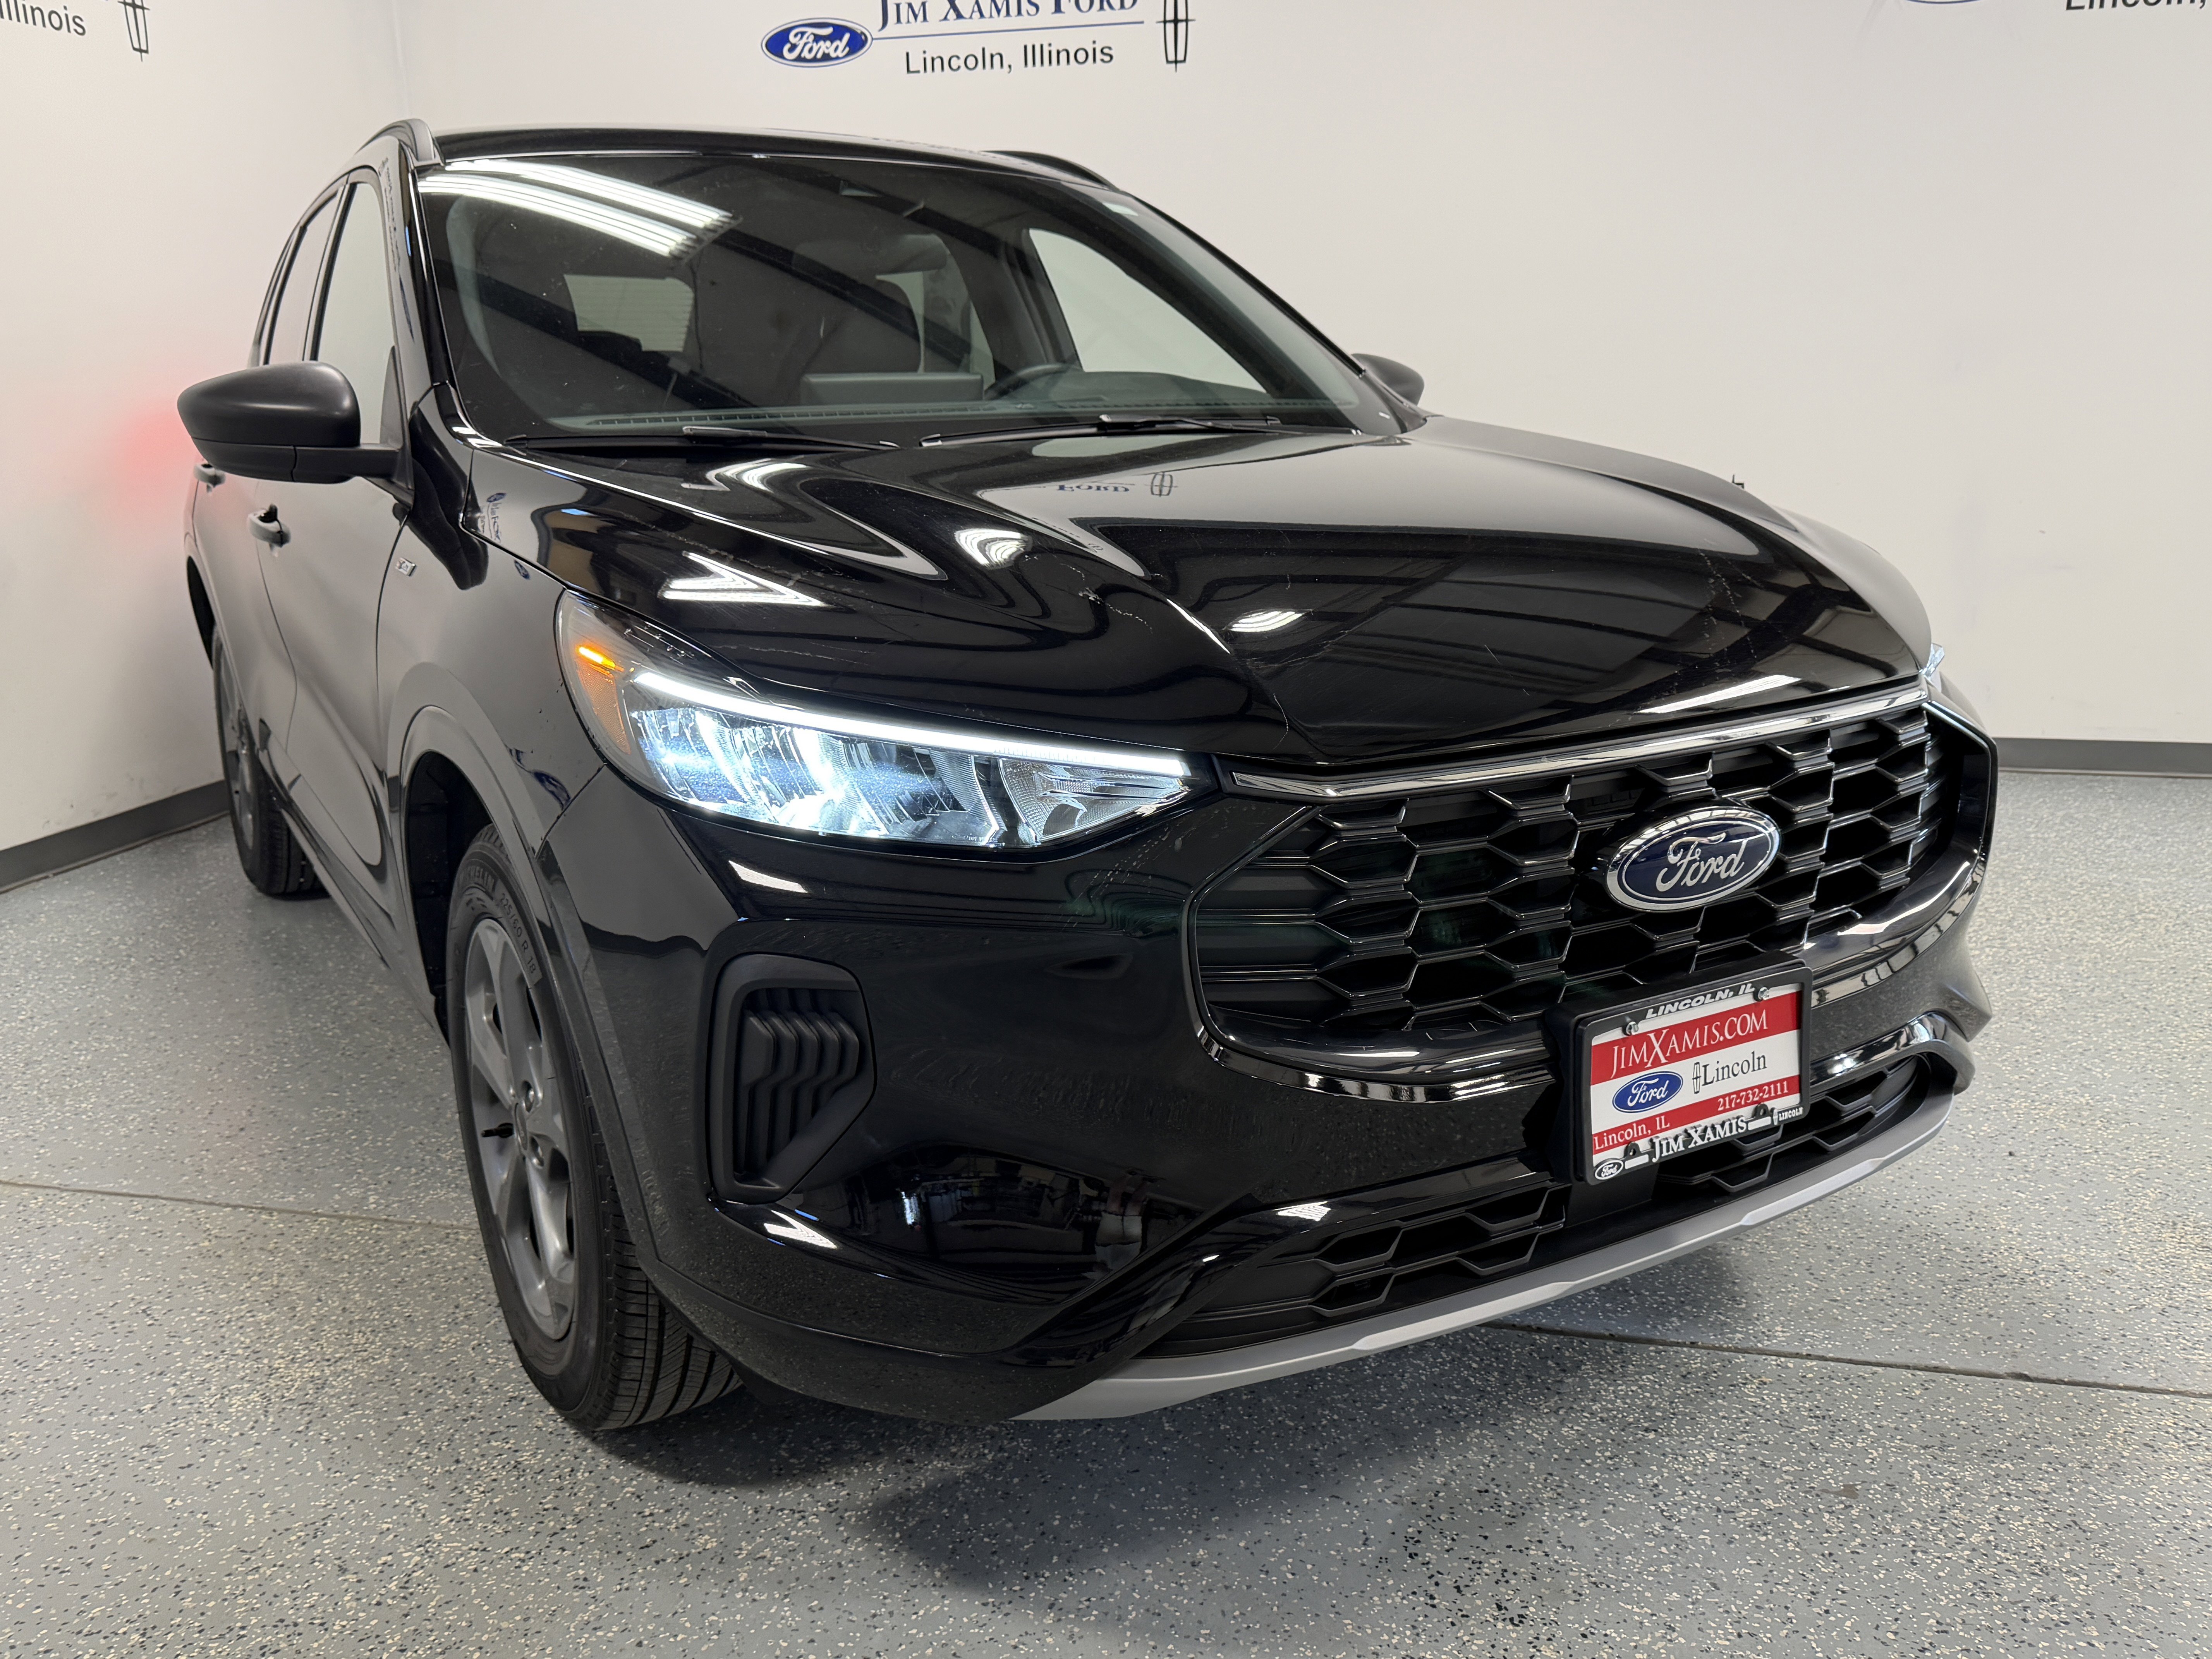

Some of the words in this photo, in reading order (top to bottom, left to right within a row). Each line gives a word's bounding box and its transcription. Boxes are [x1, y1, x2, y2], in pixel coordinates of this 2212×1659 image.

[878, 0, 929, 32] JIM
[939, 0, 1040, 22] XAMIS
[782, 26, 850, 60] Ford
[906, 46, 1012, 74] Lincoln,
[1024, 40, 1114, 68] Illinois
[1656, 832, 1748, 892] Ford
[521, 940, 529, 952] R
[1645, 988, 1734, 1019] LINCOLN,
[1738, 983, 1755, 995] IL
[1610, 1009, 1768, 1079] JIMXAMIS.COM
[1702, 1051, 1767, 1086] Lincoln
[1626, 1077, 1669, 1107] Ford
[1717, 1080, 1789, 1111] 217-732-2111
[1779, 1107, 1803, 1121] LINCOLN
[1594, 1123, 1651, 1150] Lincoln,
[1655, 1115, 1670, 1130] IL
[1652, 1135, 1685, 1163] JIM
[1688, 1116, 1747, 1149] XAMIS
[1601, 1164, 1618, 1178] Ford
